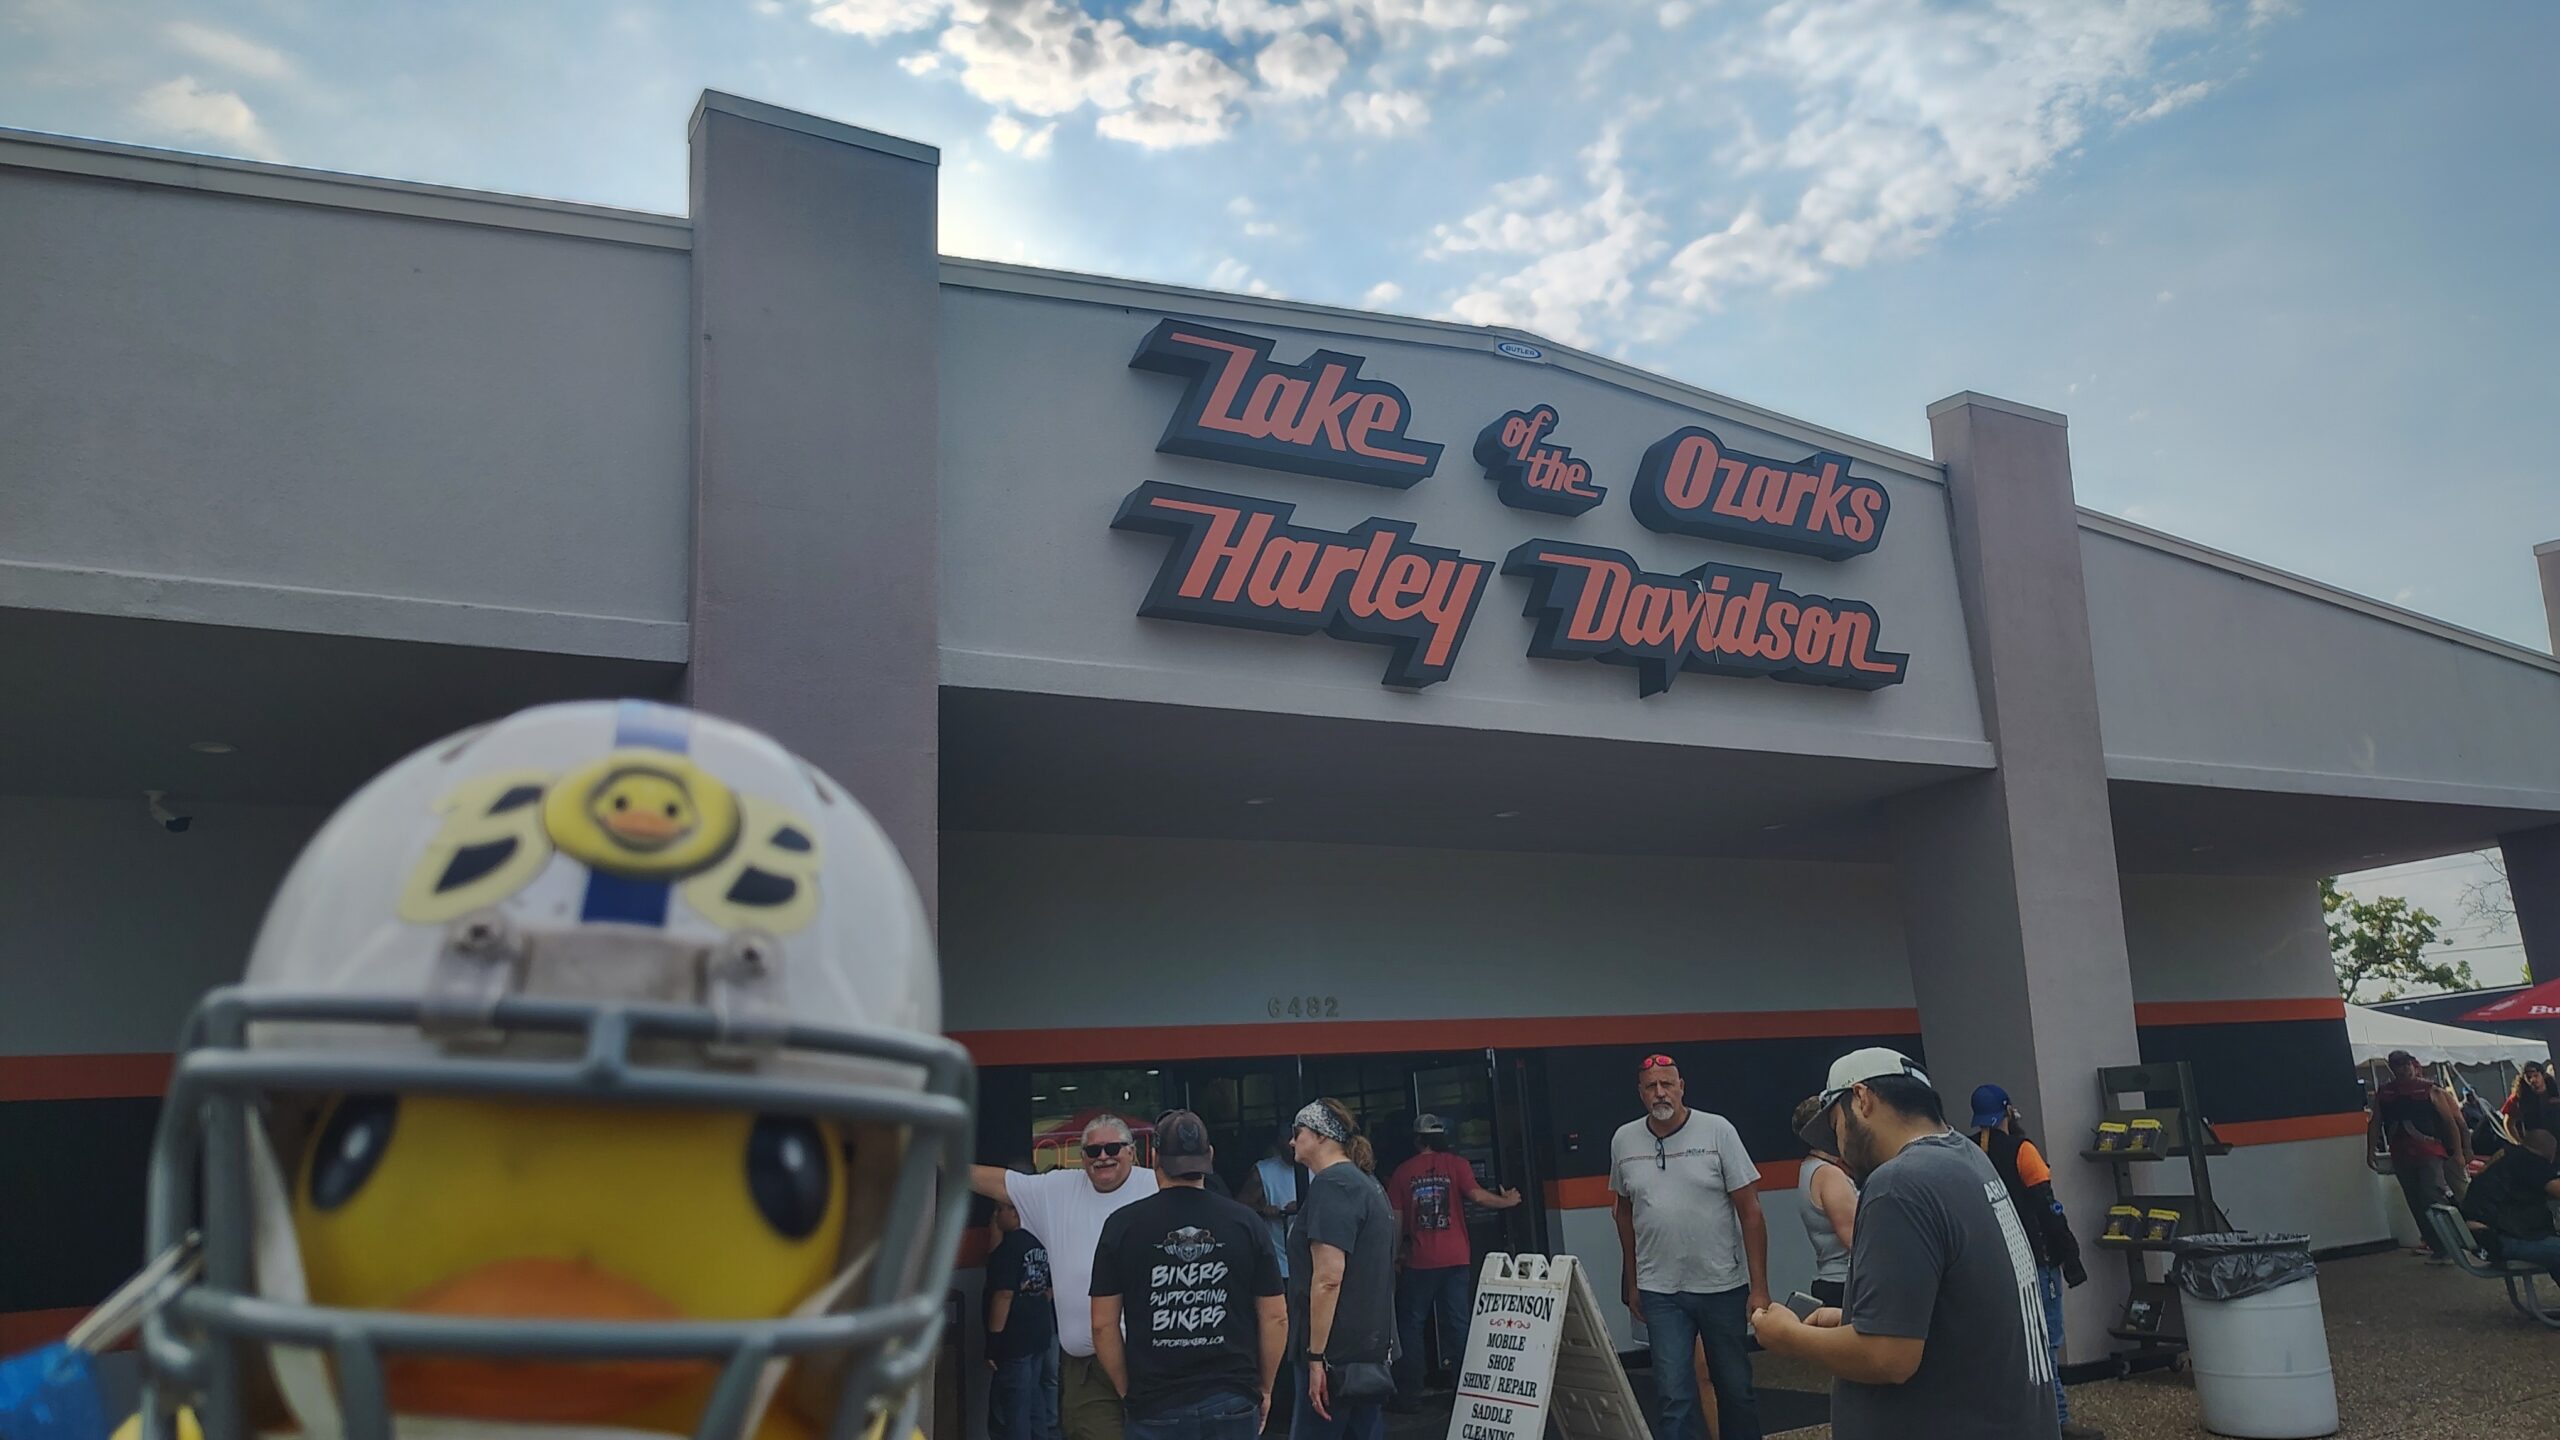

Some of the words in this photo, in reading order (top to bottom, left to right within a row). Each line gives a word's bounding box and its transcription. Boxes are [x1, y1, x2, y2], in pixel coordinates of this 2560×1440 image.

[1505, 345, 1535, 356] BUTLER
[1170, 332, 1428, 465] Lake
[1501, 411, 1552, 462] of
[1528, 448, 1600, 497] the
[1664, 436, 1881, 543] Ozarks
[1151, 497, 1485, 665] Harley
[1539, 552, 1898, 674] Davidson
[1267, 996, 1338, 1018] 6482
[1151, 1261, 1229, 1287] BIKERS
[1150, 1288, 1228, 1306] SUPPORTING
[1476, 1292, 1555, 1322] STEVENSON
[1152, 1305, 1227, 1332] BIKERS
[1486, 1333, 1526, 1351] MOBILE
[1487, 1354, 1516, 1372] SHOE
[1462, 1372, 1491, 1390] SHINE
[1497, 1377, 1538, 1398] REPAIR
[1471, 1403, 1513, 1424] SADDLE
[1462, 1423, 1515, 1440] CLEANING
